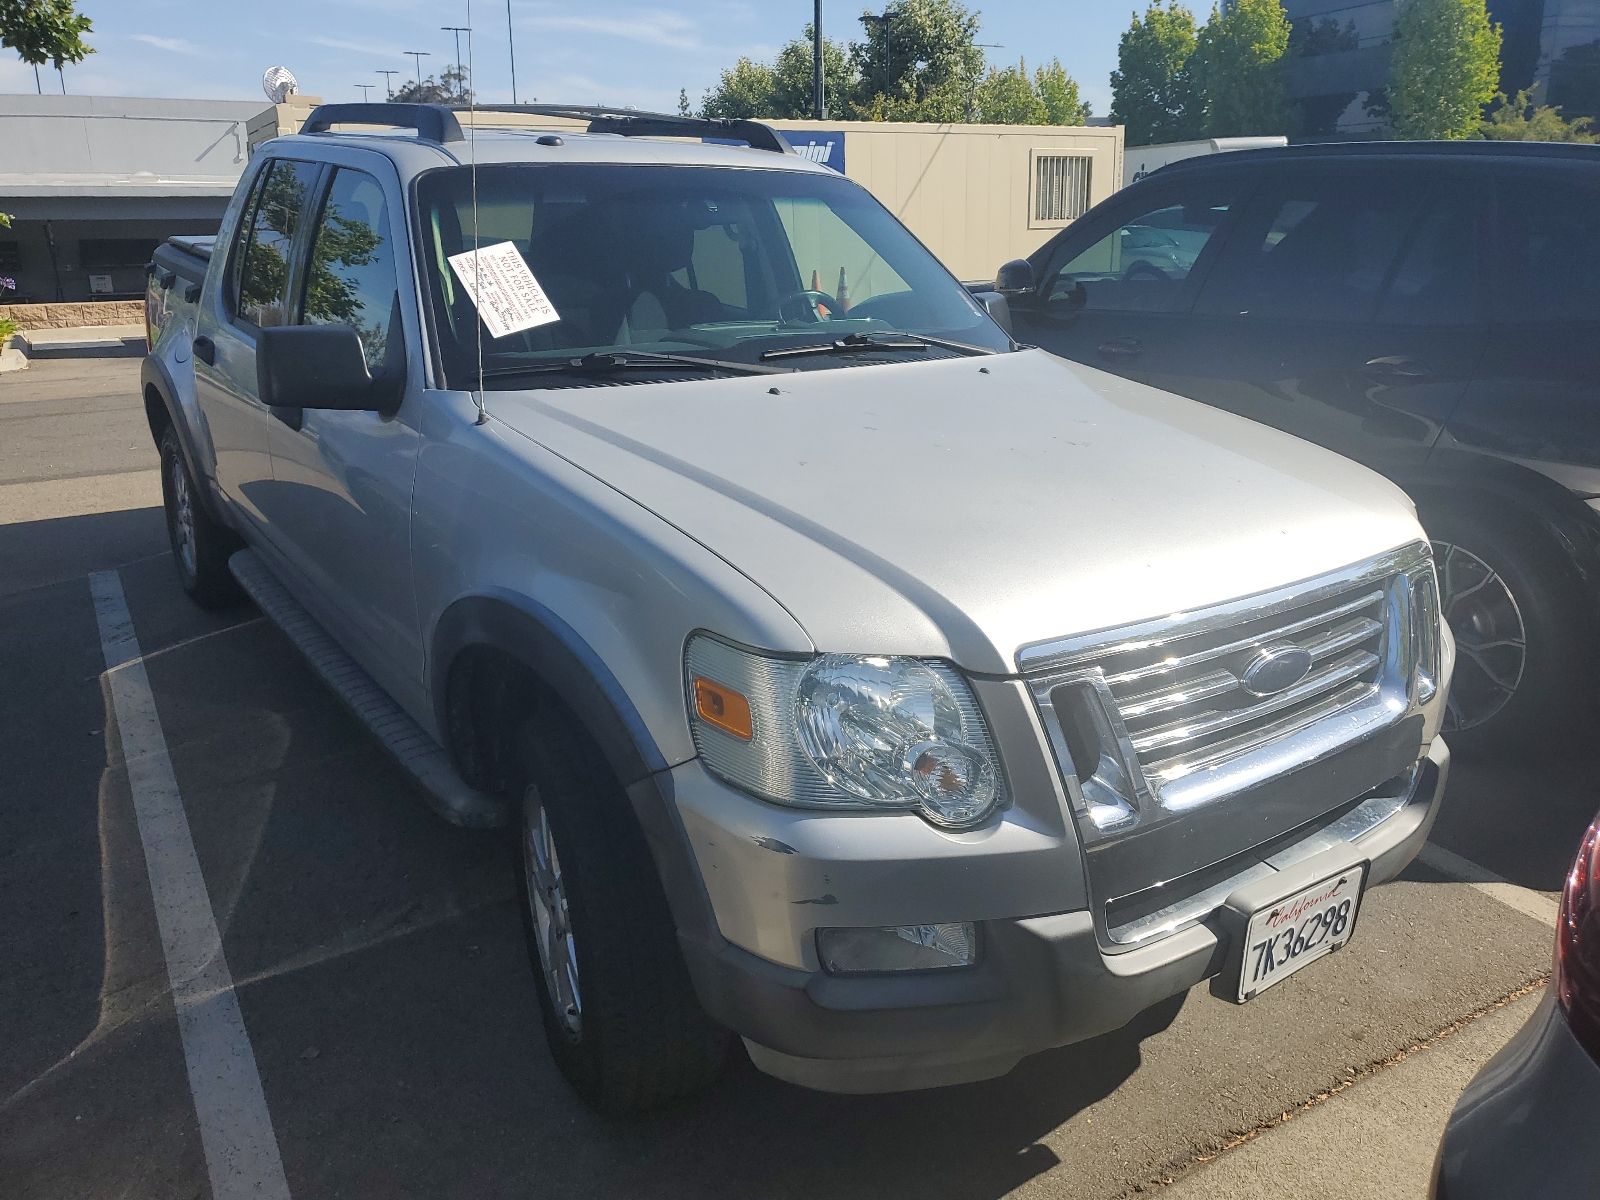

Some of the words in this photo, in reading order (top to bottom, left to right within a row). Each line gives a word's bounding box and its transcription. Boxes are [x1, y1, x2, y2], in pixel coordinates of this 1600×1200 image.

[498, 255, 514, 272] NOT
[509, 274, 525, 290] FOR
[520, 292, 539, 313] SALE
[505, 249, 522, 268] THIS
[517, 269, 544, 303] VEHICLE
[539, 305, 551, 314] IS
[1270, 887, 1341, 928] California
[1252, 899, 1351, 982] 7K36298
